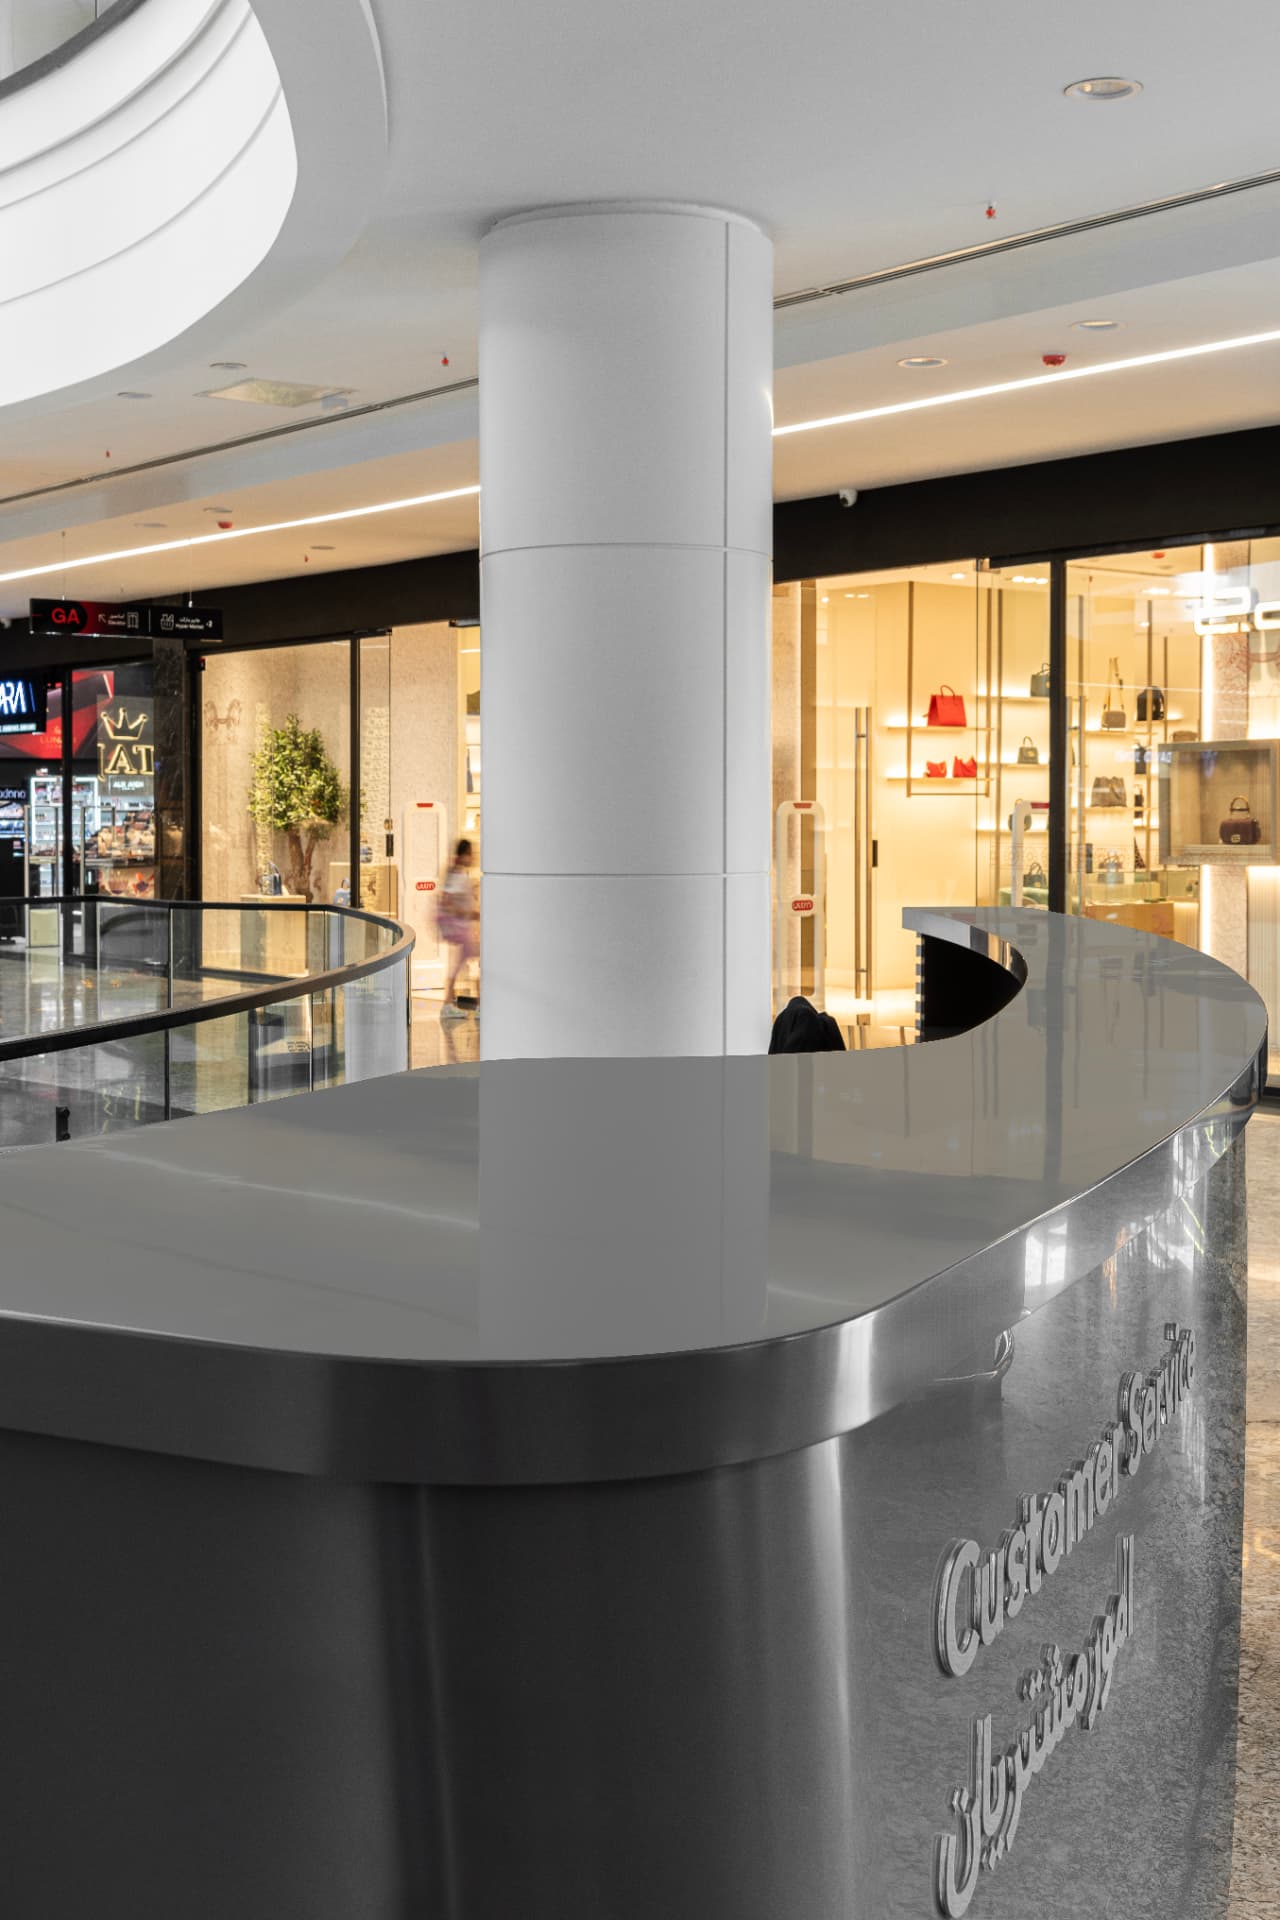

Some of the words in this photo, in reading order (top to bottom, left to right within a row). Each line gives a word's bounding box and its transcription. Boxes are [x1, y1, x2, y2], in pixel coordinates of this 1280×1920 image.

[51, 607, 81, 625] GA
[933, 1420, 1122, 1677] Customer
[1117, 1322, 1196, 1477] Service
[1081, 1533, 1134, 1730] امور
[934, 1643, 1087, 1919] مشتریان
